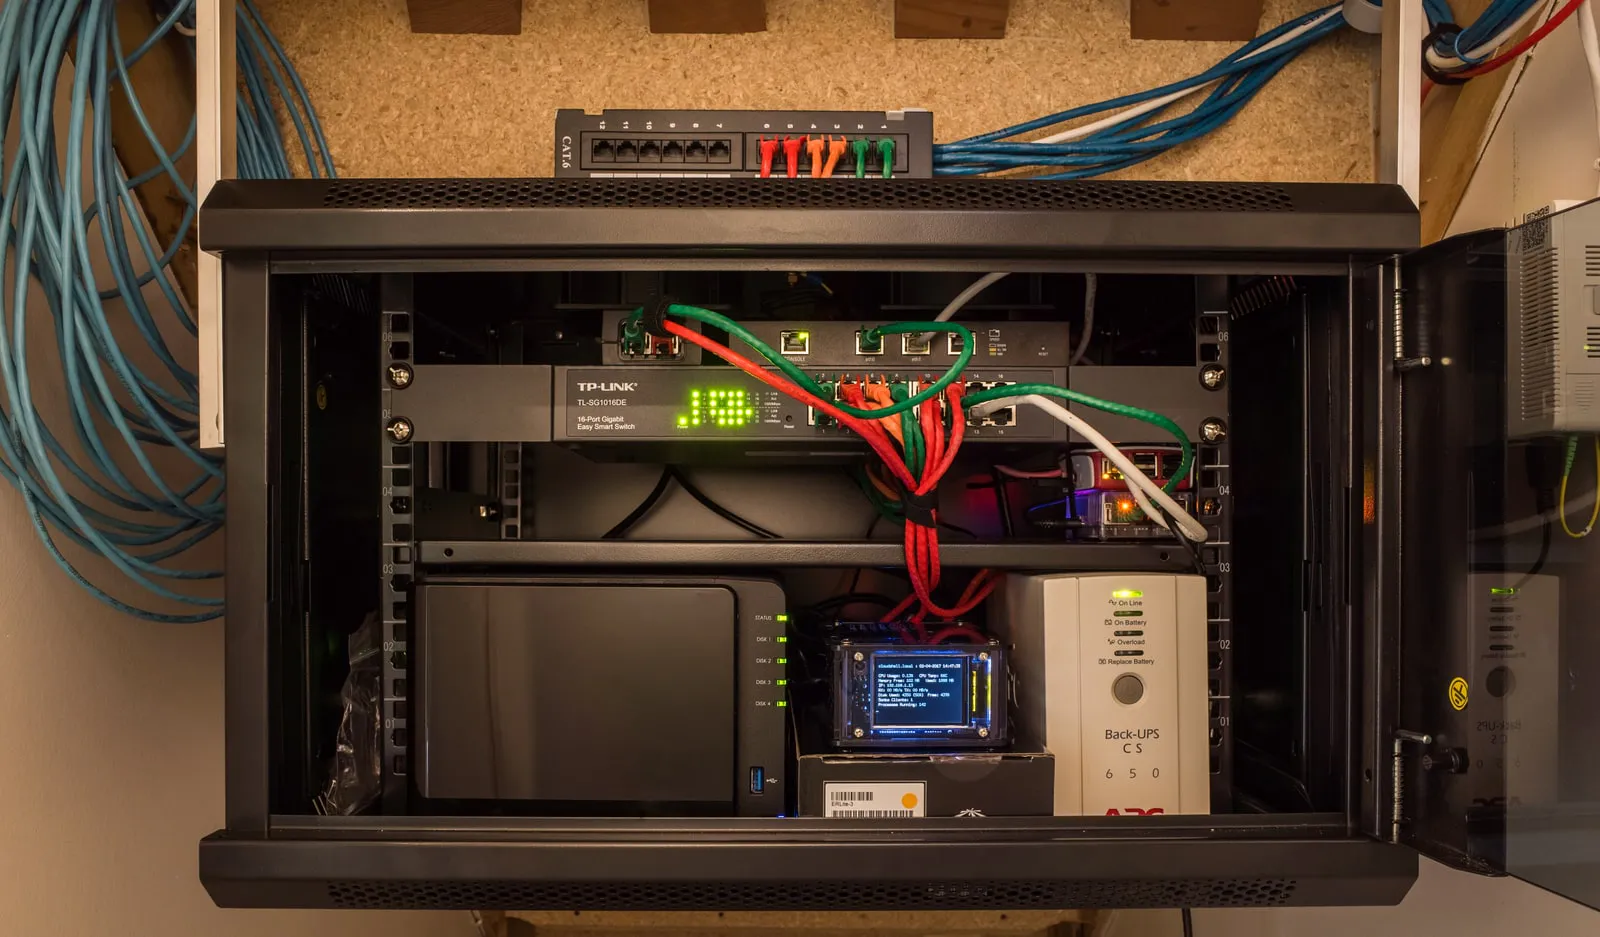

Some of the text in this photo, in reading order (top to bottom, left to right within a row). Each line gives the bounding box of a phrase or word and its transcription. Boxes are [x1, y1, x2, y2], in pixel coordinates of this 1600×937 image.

[600, 121, 606, 130] 12
[623, 121, 629, 129] 11
[646, 121, 652, 130] 10
[562, 136, 572, 168] CAT.6
[382, 332, 392, 341] 06
[1218, 332, 1228, 341] 06
[382, 487, 393, 496] 04
[1219, 486, 1230, 495] 04
[383, 564, 393, 574] 03
[1220, 563, 1230, 572] 03
[383, 642, 394, 651] 02
[1220, 640, 1230, 649] 02
[385, 720, 395, 728] 01
[1220, 717, 1230, 726] 01
[1104, 728, 1160, 740] Back-UPS
